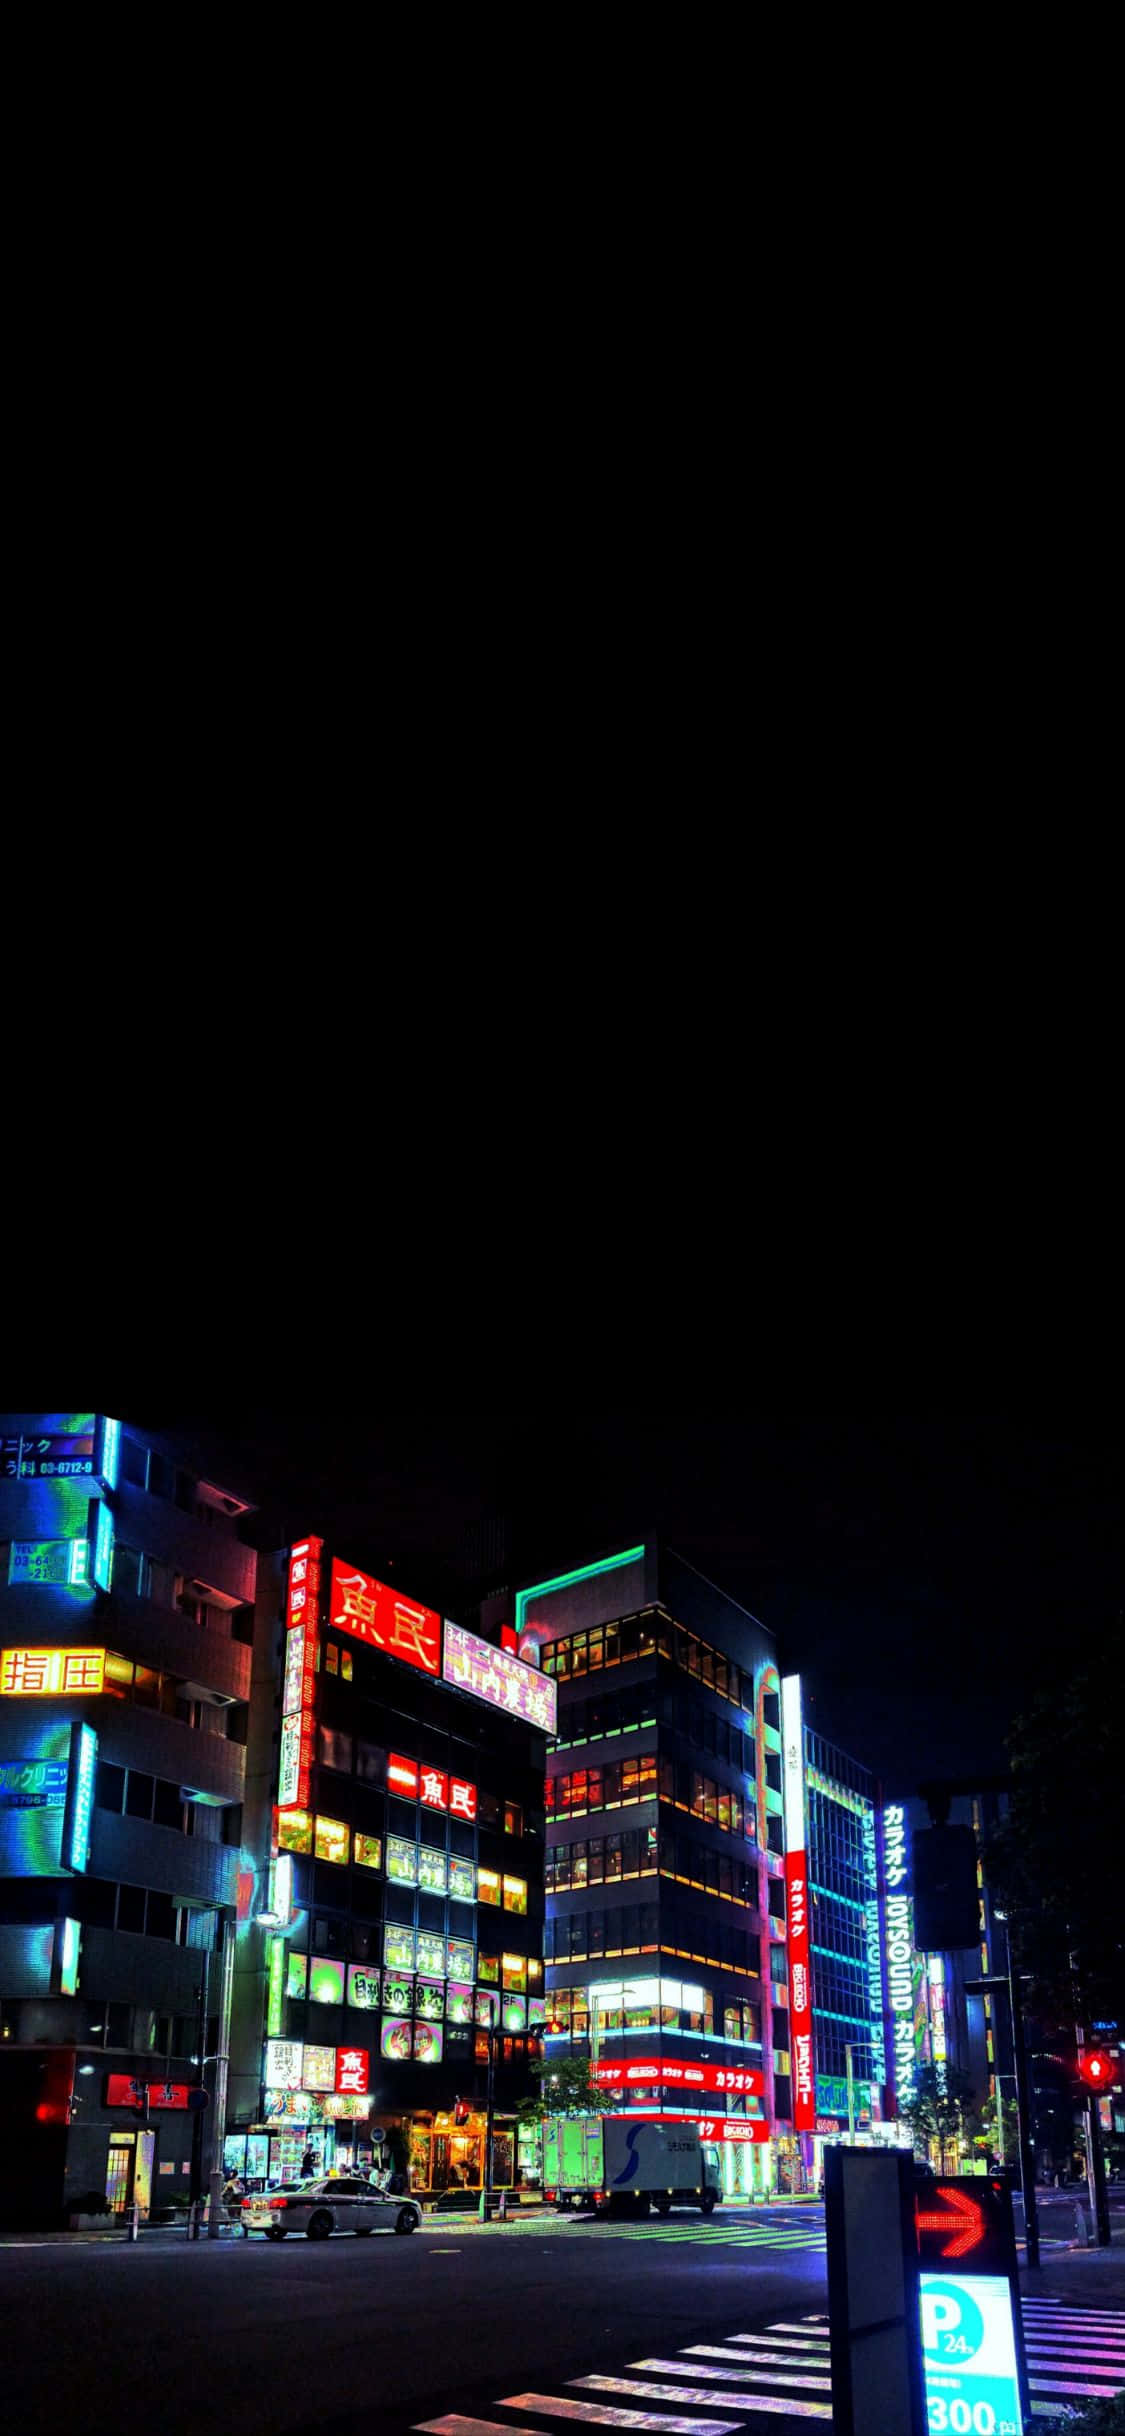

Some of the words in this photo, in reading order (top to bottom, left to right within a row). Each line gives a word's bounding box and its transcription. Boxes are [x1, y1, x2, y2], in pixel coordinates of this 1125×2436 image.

[0, 1439, 51, 1453] ニック
[334, 1574, 436, 1670] 魚民
[4, 1652, 102, 1690] 指圧
[421, 1772, 476, 1818] 魚民
[883, 1805, 907, 1886] カラオケ
[791, 1879, 805, 1937] カラオケ
[886, 1895, 913, 2011] JOYSOUND
[340, 2051, 367, 2093] 魚民
[715, 2071, 755, 2090] カラオケ
[921, 2293, 961, 2350] P
